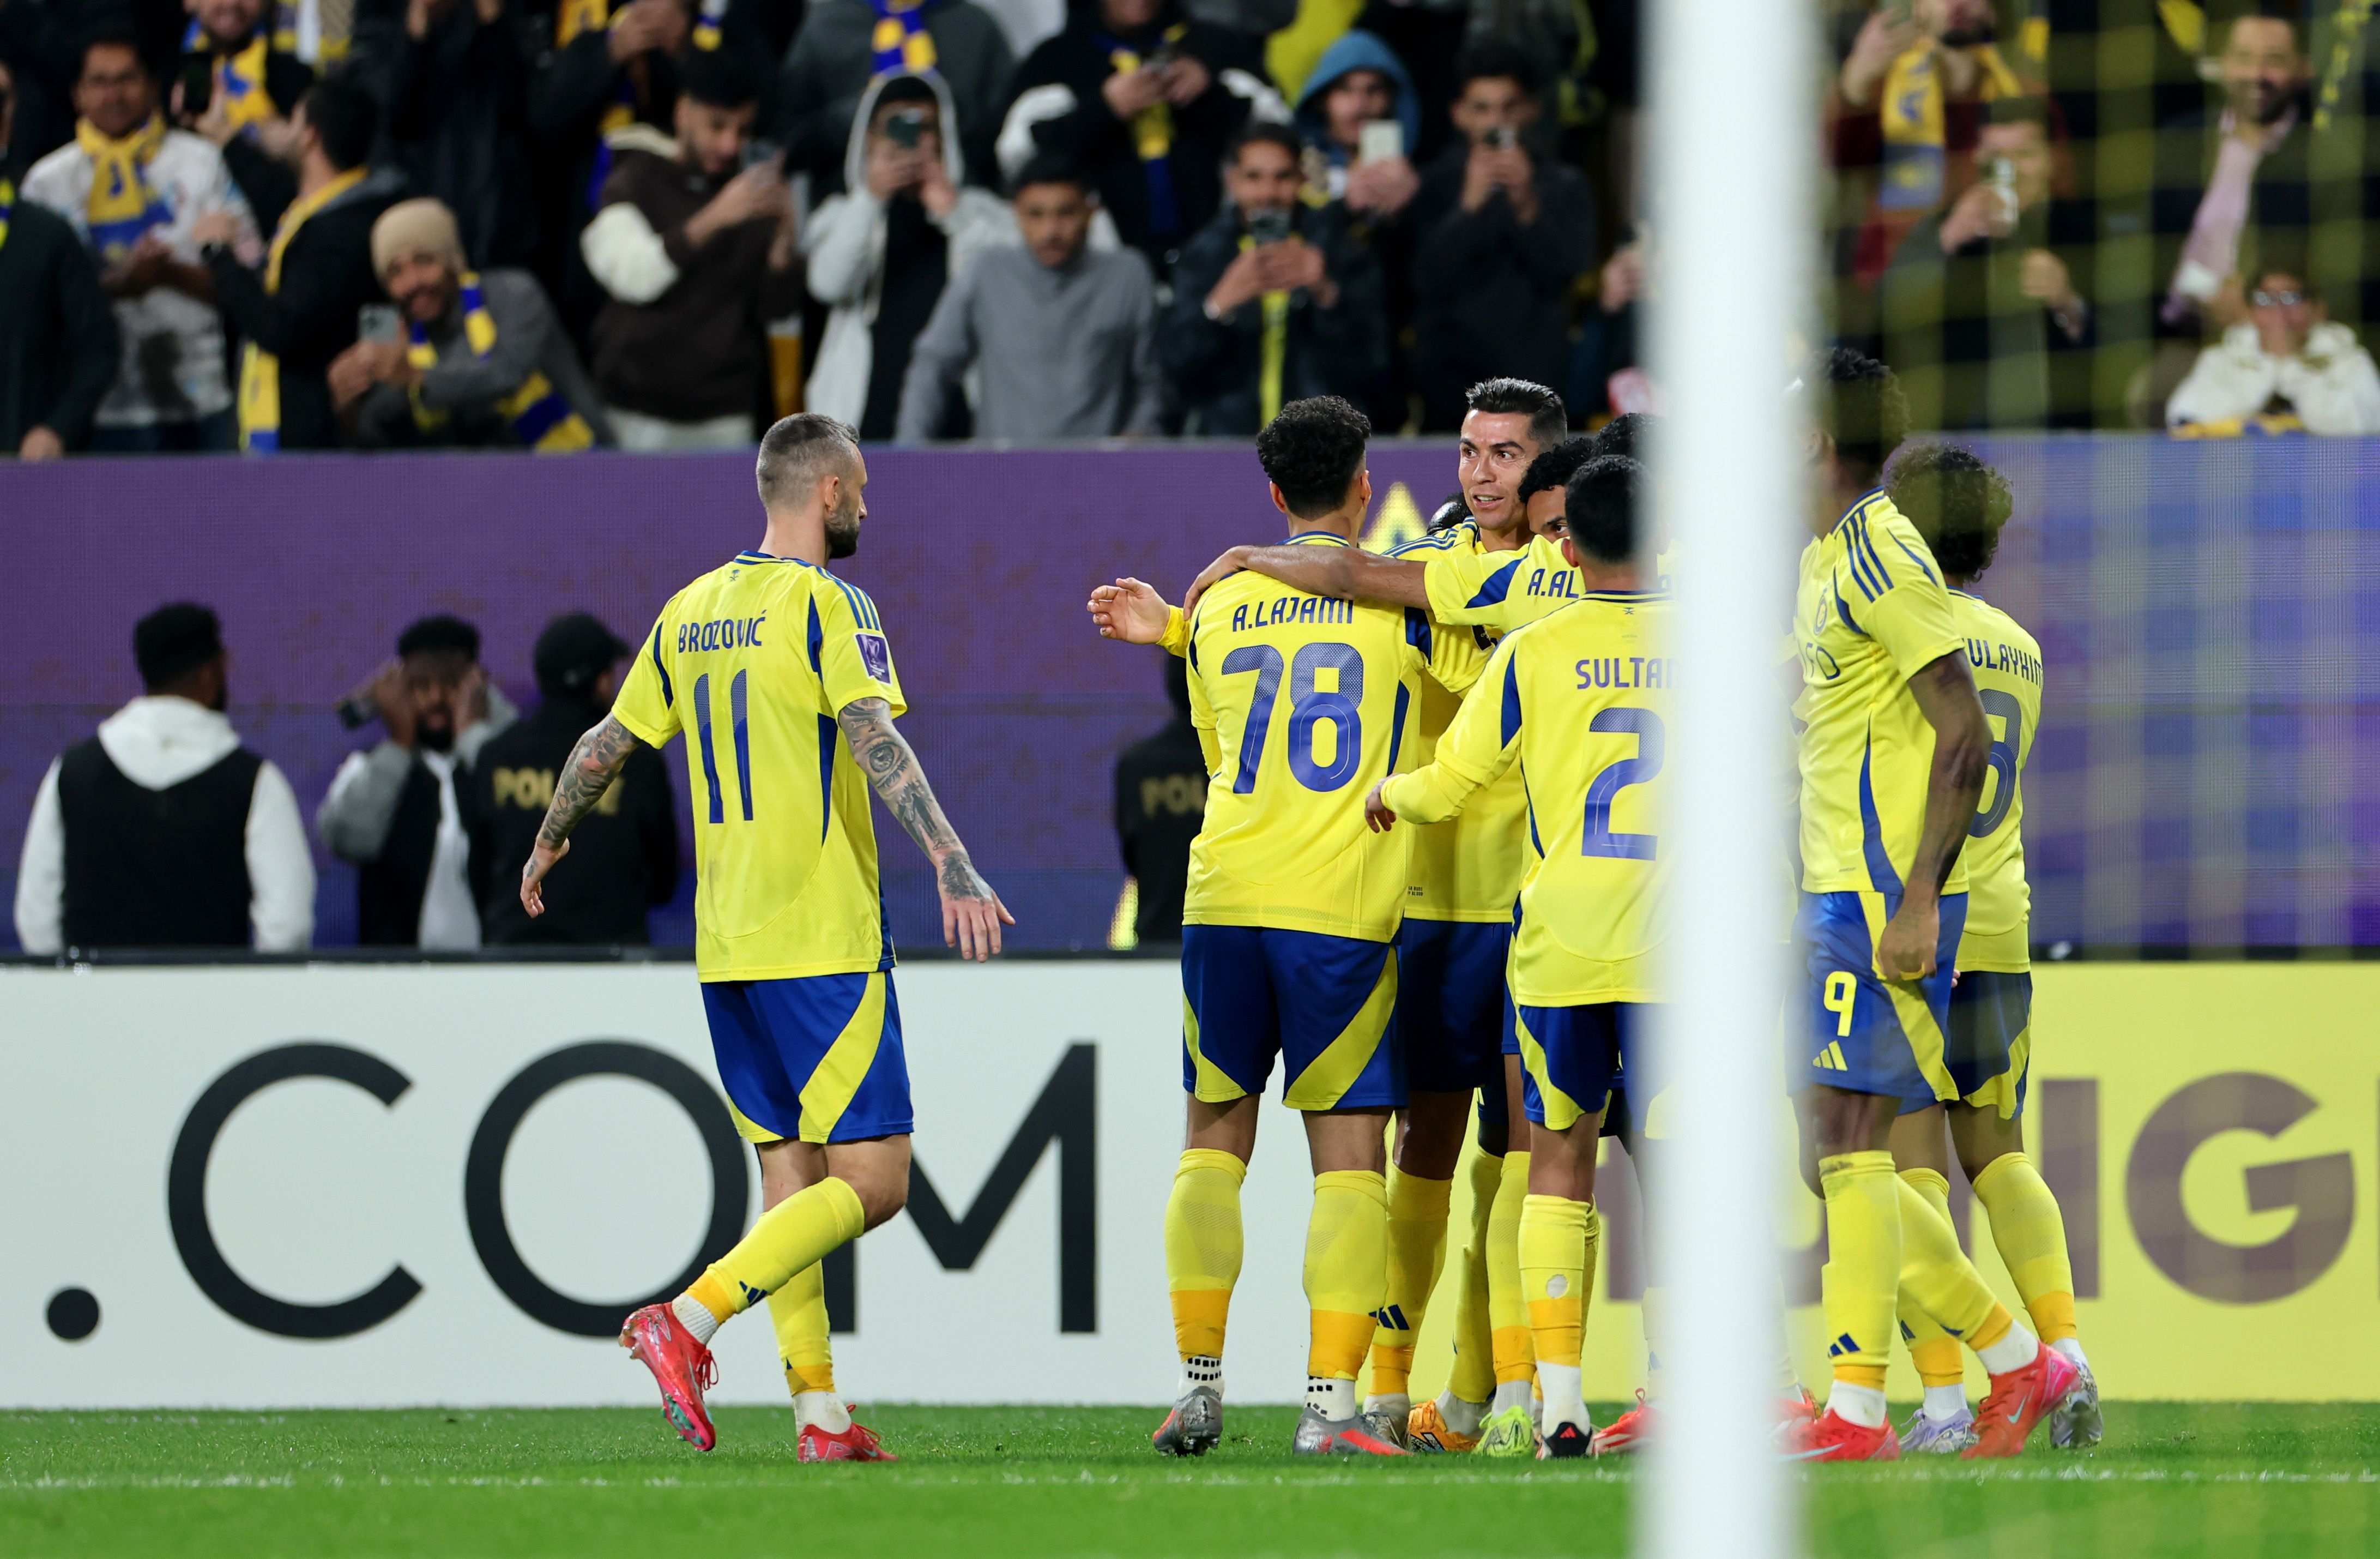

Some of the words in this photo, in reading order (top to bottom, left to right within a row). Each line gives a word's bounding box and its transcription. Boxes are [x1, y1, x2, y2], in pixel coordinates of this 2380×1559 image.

[678, 609, 767, 653] BROZOVIĆ
[1232, 596, 1354, 633] A.LAJAMI
[693, 669, 754, 824] 11
[1221, 642, 1364, 794] 78
[1581, 707, 1666, 861] 2
[1823, 970, 1858, 1037] 9
[45, 1038, 1099, 1341] .COM
